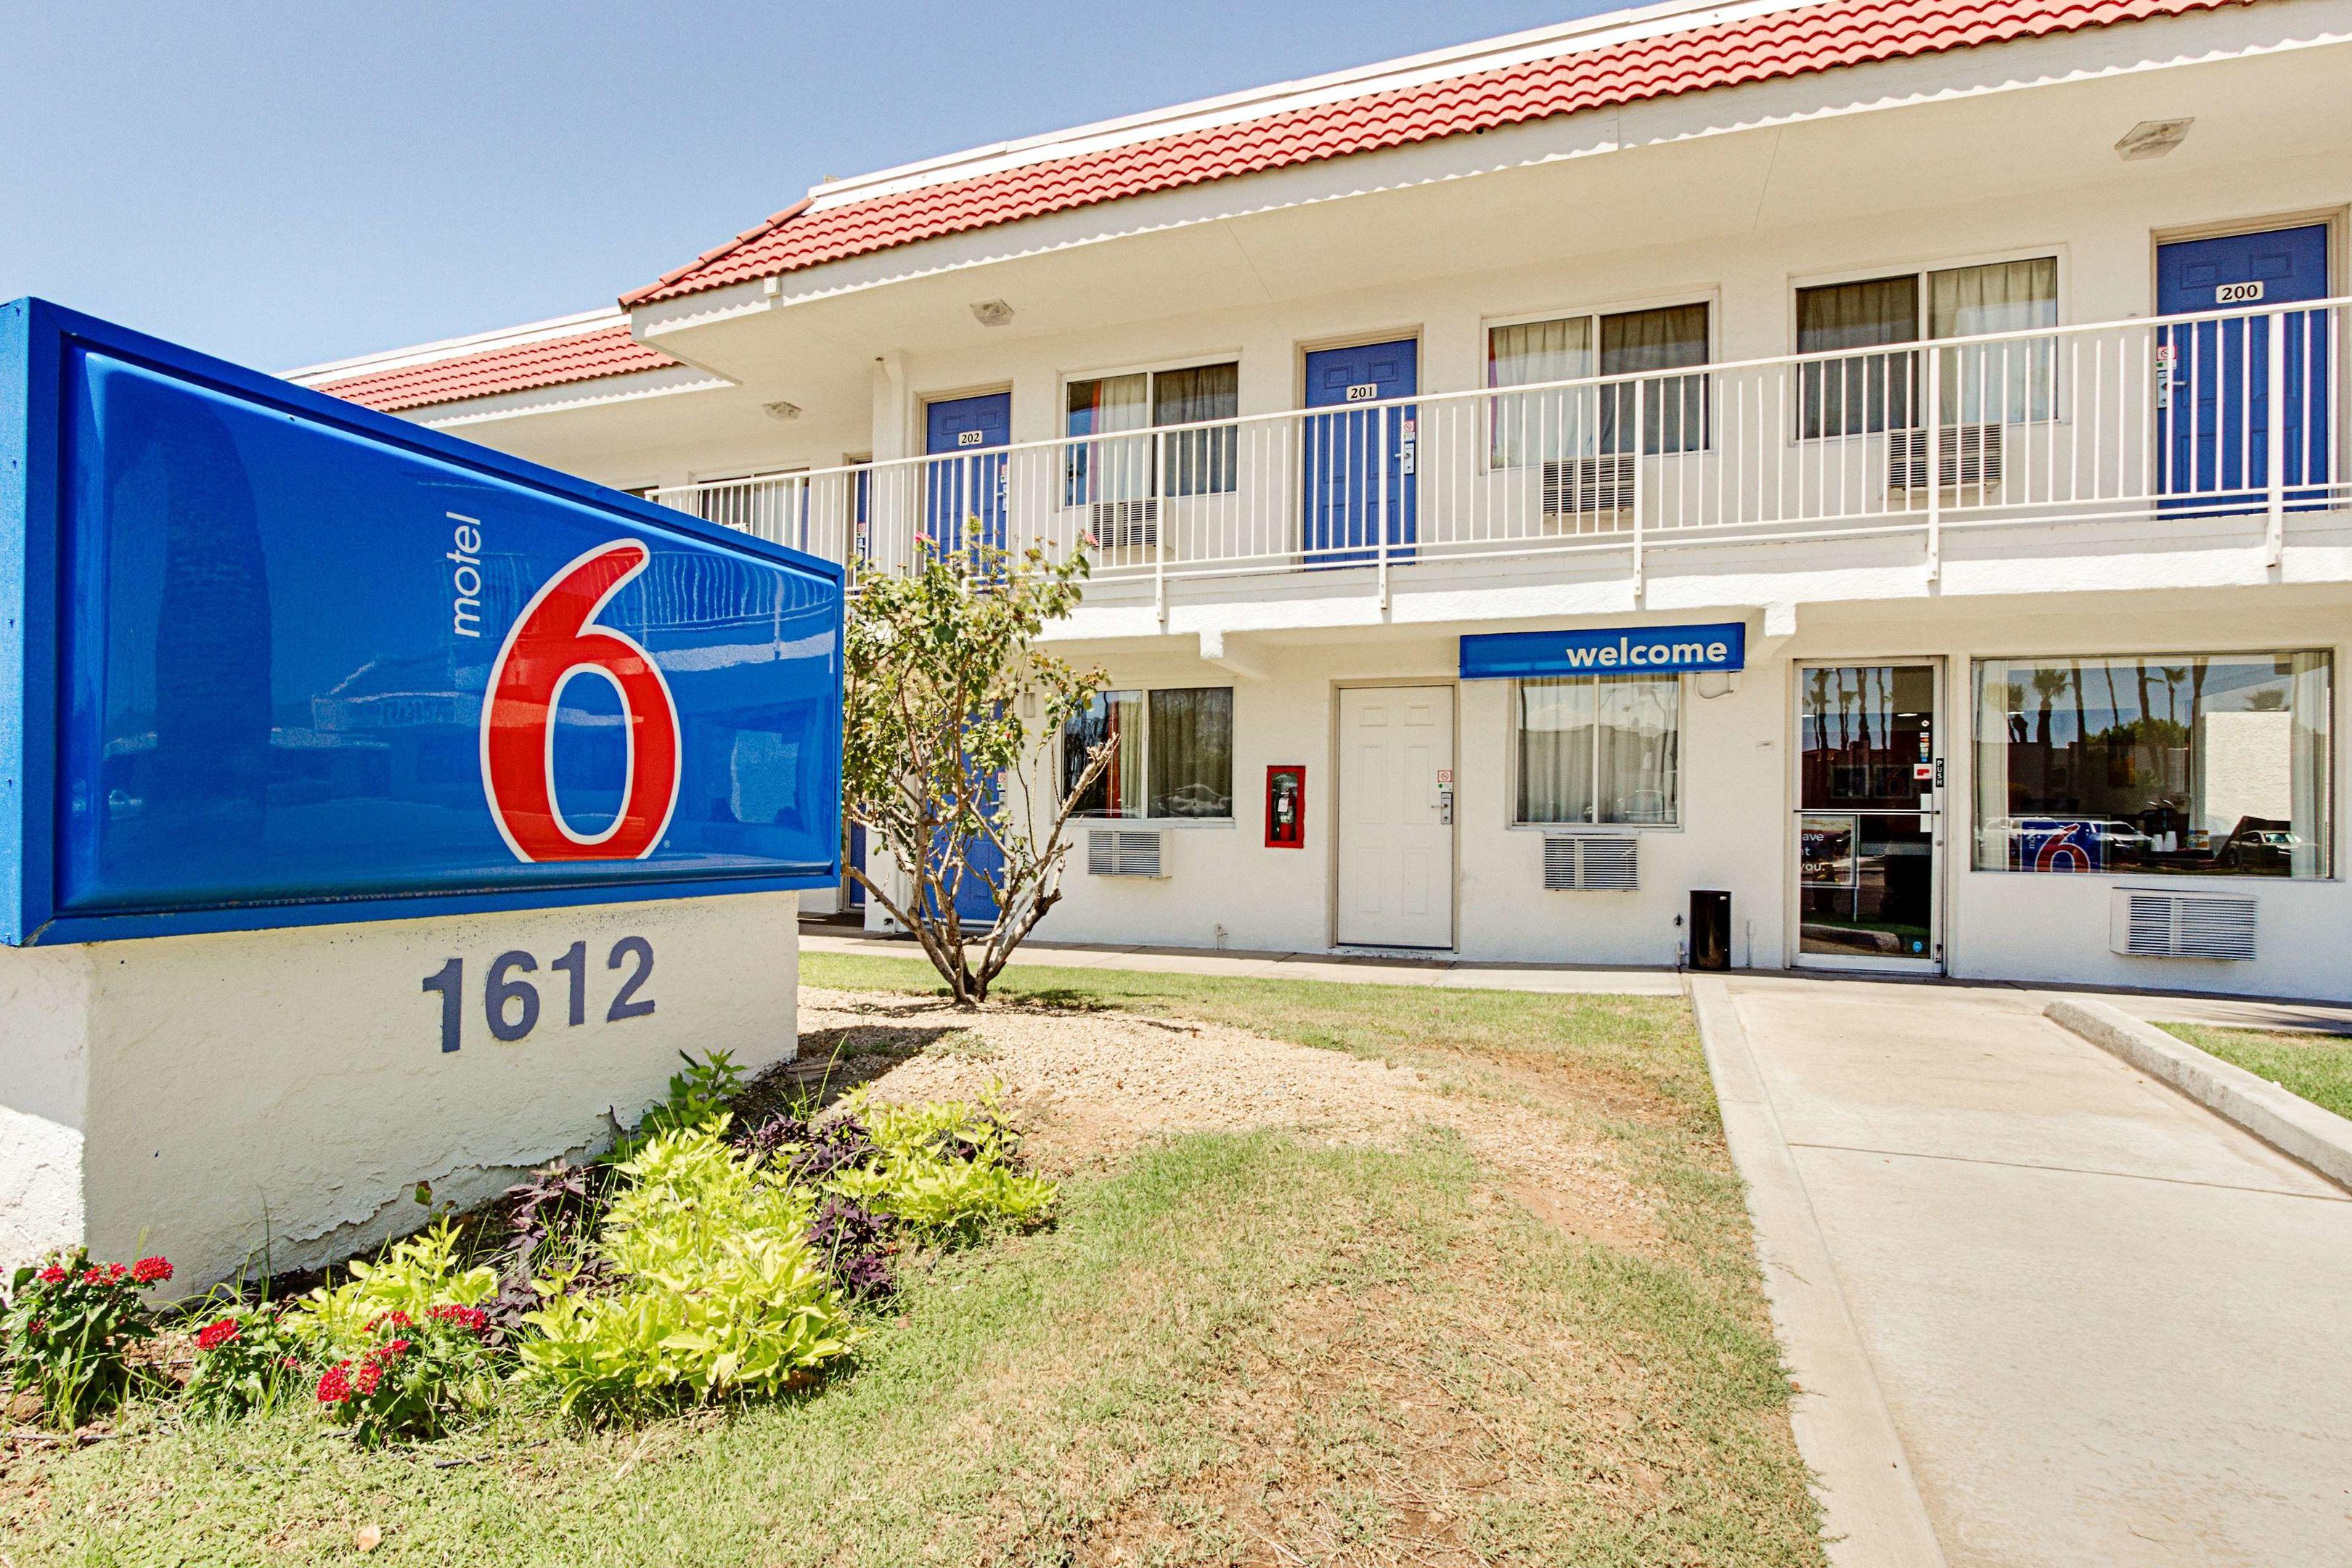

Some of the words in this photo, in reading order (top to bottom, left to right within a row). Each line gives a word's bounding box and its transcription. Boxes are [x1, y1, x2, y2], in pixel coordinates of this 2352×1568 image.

[2221, 284, 2258, 301] 200
[1350, 386, 1373, 399] 201
[960, 433, 980, 444] 202
[446, 511, 481, 637] motel
[1566, 637, 1728, 667] welcome
[480, 538, 682, 862] 6
[422, 936, 656, 1053] 1612
